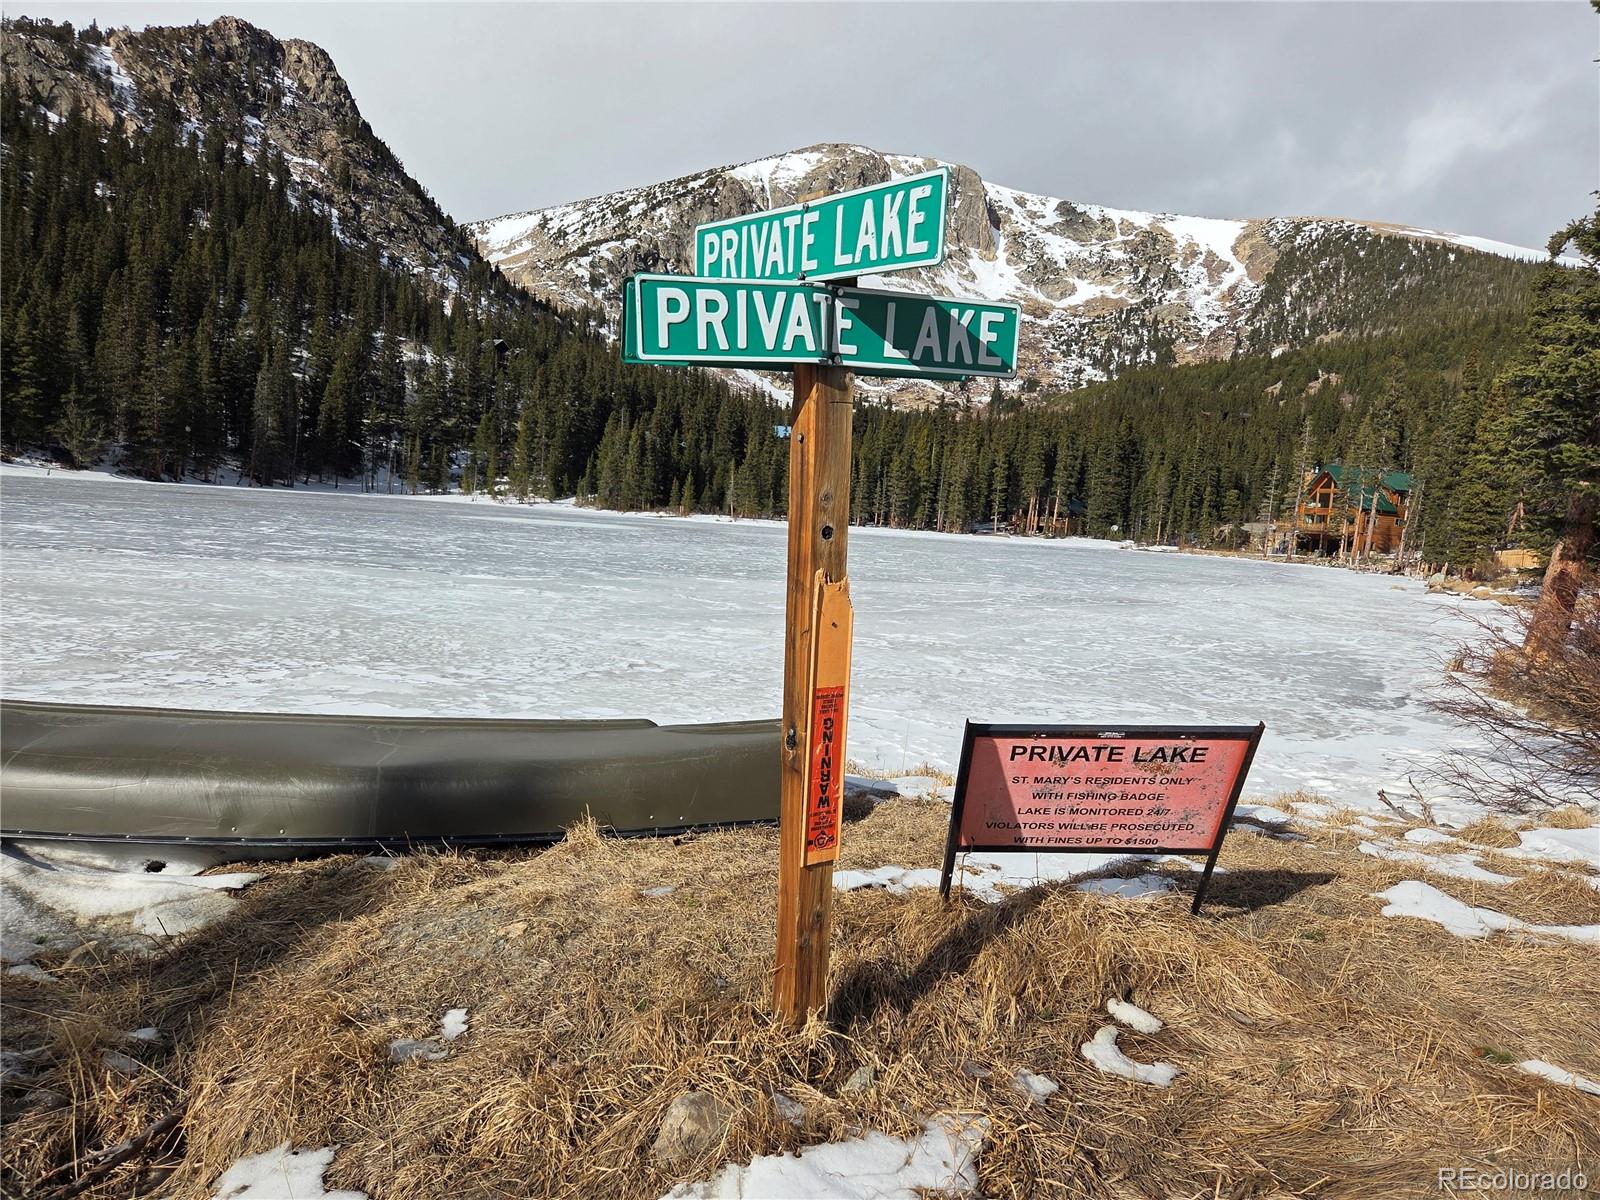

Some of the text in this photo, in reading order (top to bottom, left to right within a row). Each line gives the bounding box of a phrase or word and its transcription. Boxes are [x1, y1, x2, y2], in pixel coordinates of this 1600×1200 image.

[703, 184, 933, 278] PRIVATE LAKE
[656, 287, 1005, 367] PRIVATE LAKE
[1009, 745, 1209, 763] PRIVATE LAKE
[817, 717, 834, 809] WARNING
[1011, 776, 1193, 785] ST. MARY'S RESIDENTS ONLY
[1031, 792, 1165, 801] WITH FISHING BADGE
[1017, 807, 1171, 816] LAKE IS MONITORED 24/7
[985, 822, 1194, 831] VIOLATORS WILL BE PROSECUTED
[1013, 836, 1044, 844] WITH
[1106, 837, 1122, 845] TO
[1124, 837, 1159, 845] $1500
